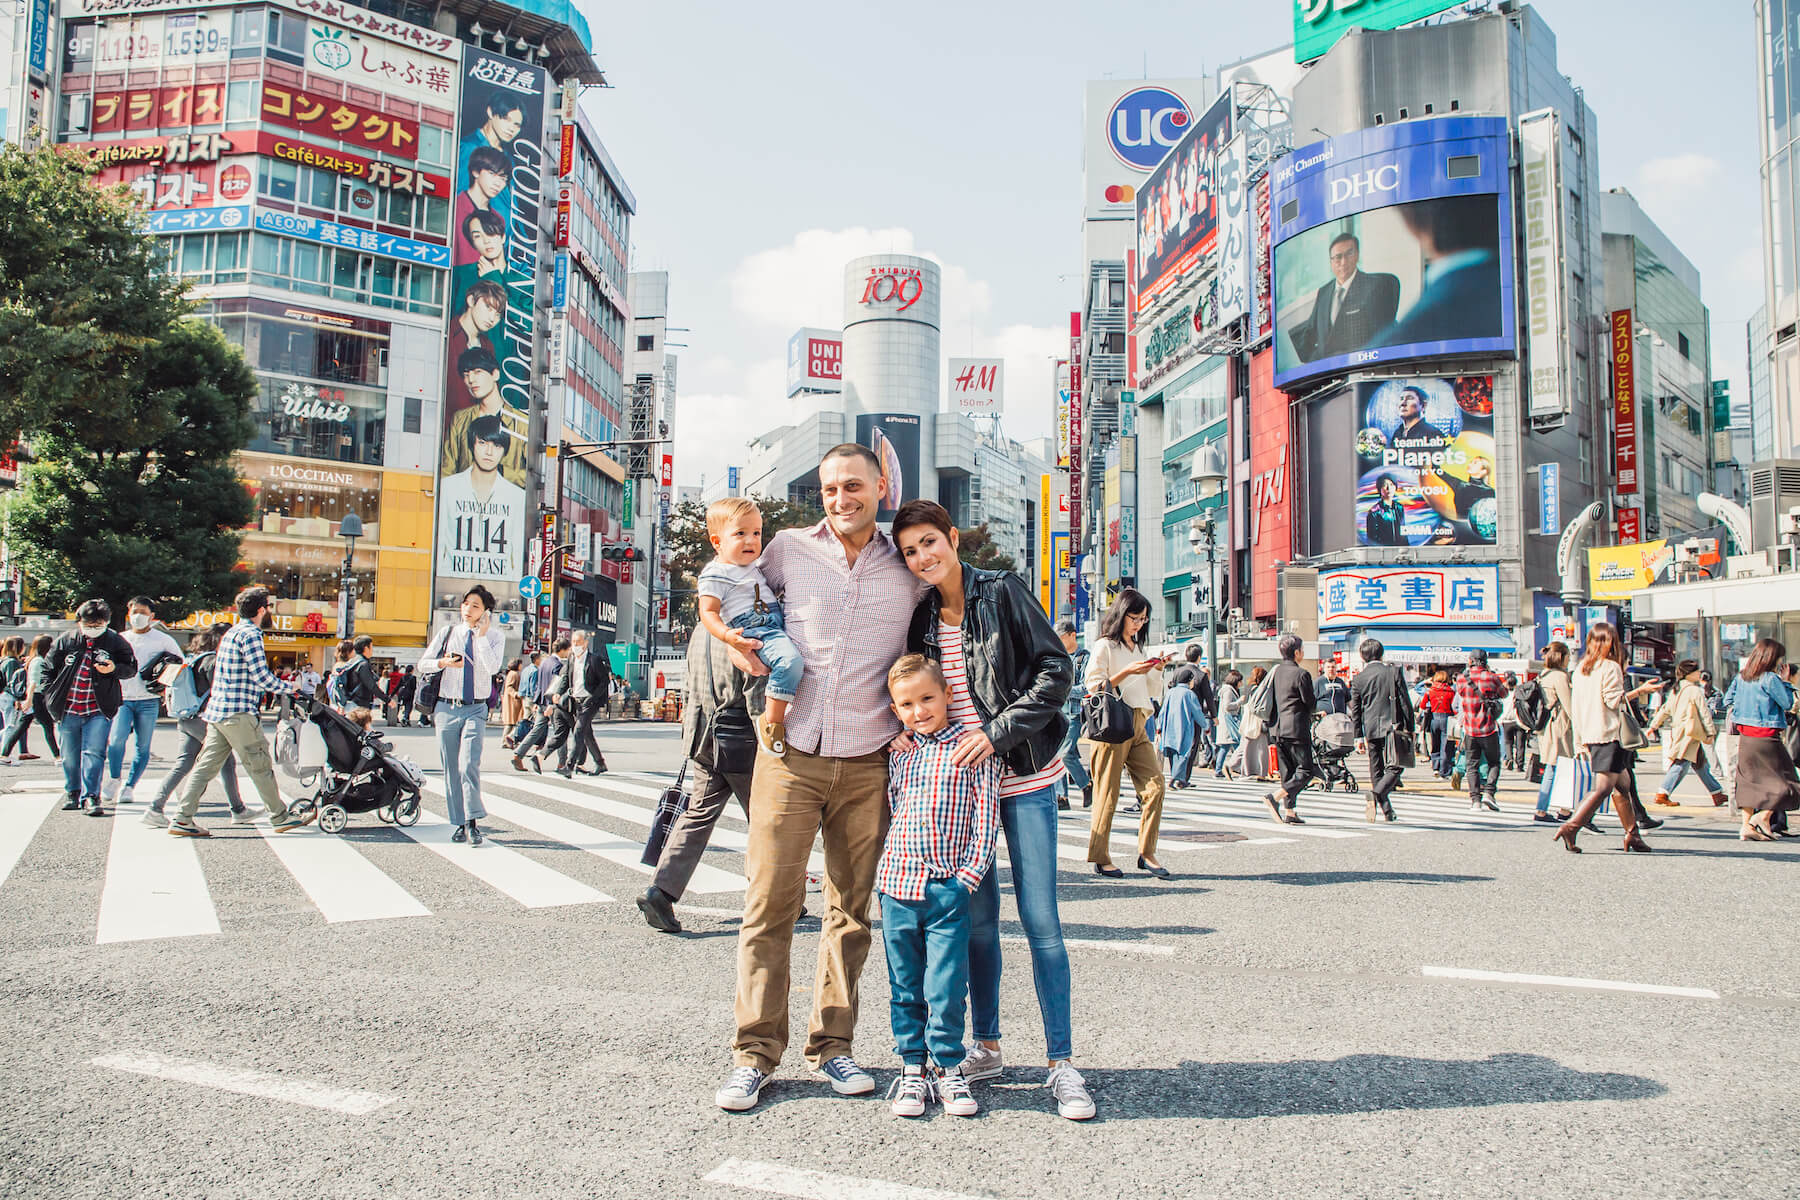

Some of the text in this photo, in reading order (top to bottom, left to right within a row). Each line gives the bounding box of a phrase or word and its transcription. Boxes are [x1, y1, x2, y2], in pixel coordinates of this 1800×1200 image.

[68, 38, 94, 56] 9F
[361, 45, 450, 93] しゃぶ葉
[96, 89, 221, 124] プライス
[263, 87, 414, 147] コンタクト
[166, 133, 234, 164] ガスト
[1295, 146, 1334, 173] Channel
[274, 142, 436, 196] Caféレストラン ガスト
[1329, 163, 1400, 204] DHC
[262, 212, 310, 235] AEON
[871, 266, 921, 277] SHIBUYA
[858, 274, 923, 312] 109
[1530, 256, 1549, 336] neon
[812, 343, 841, 360] UNI
[1358, 350, 1379, 361] DHC
[811, 359, 842, 376] QLO
[955, 364, 997, 393] H&M
[1616, 314, 1635, 486] クスリのことなら 三千里
[1393, 435, 1445, 448] teamLab
[1382, 447, 1467, 467] Planets
[269, 464, 354, 486] L'OCCITANE
[1403, 485, 1449, 496] TOYOSU
[455, 500, 482, 513] NEW
[454, 515, 508, 554] 11.14
[452, 553, 508, 577] RELEASE
[598, 600, 617, 625] LUSH
